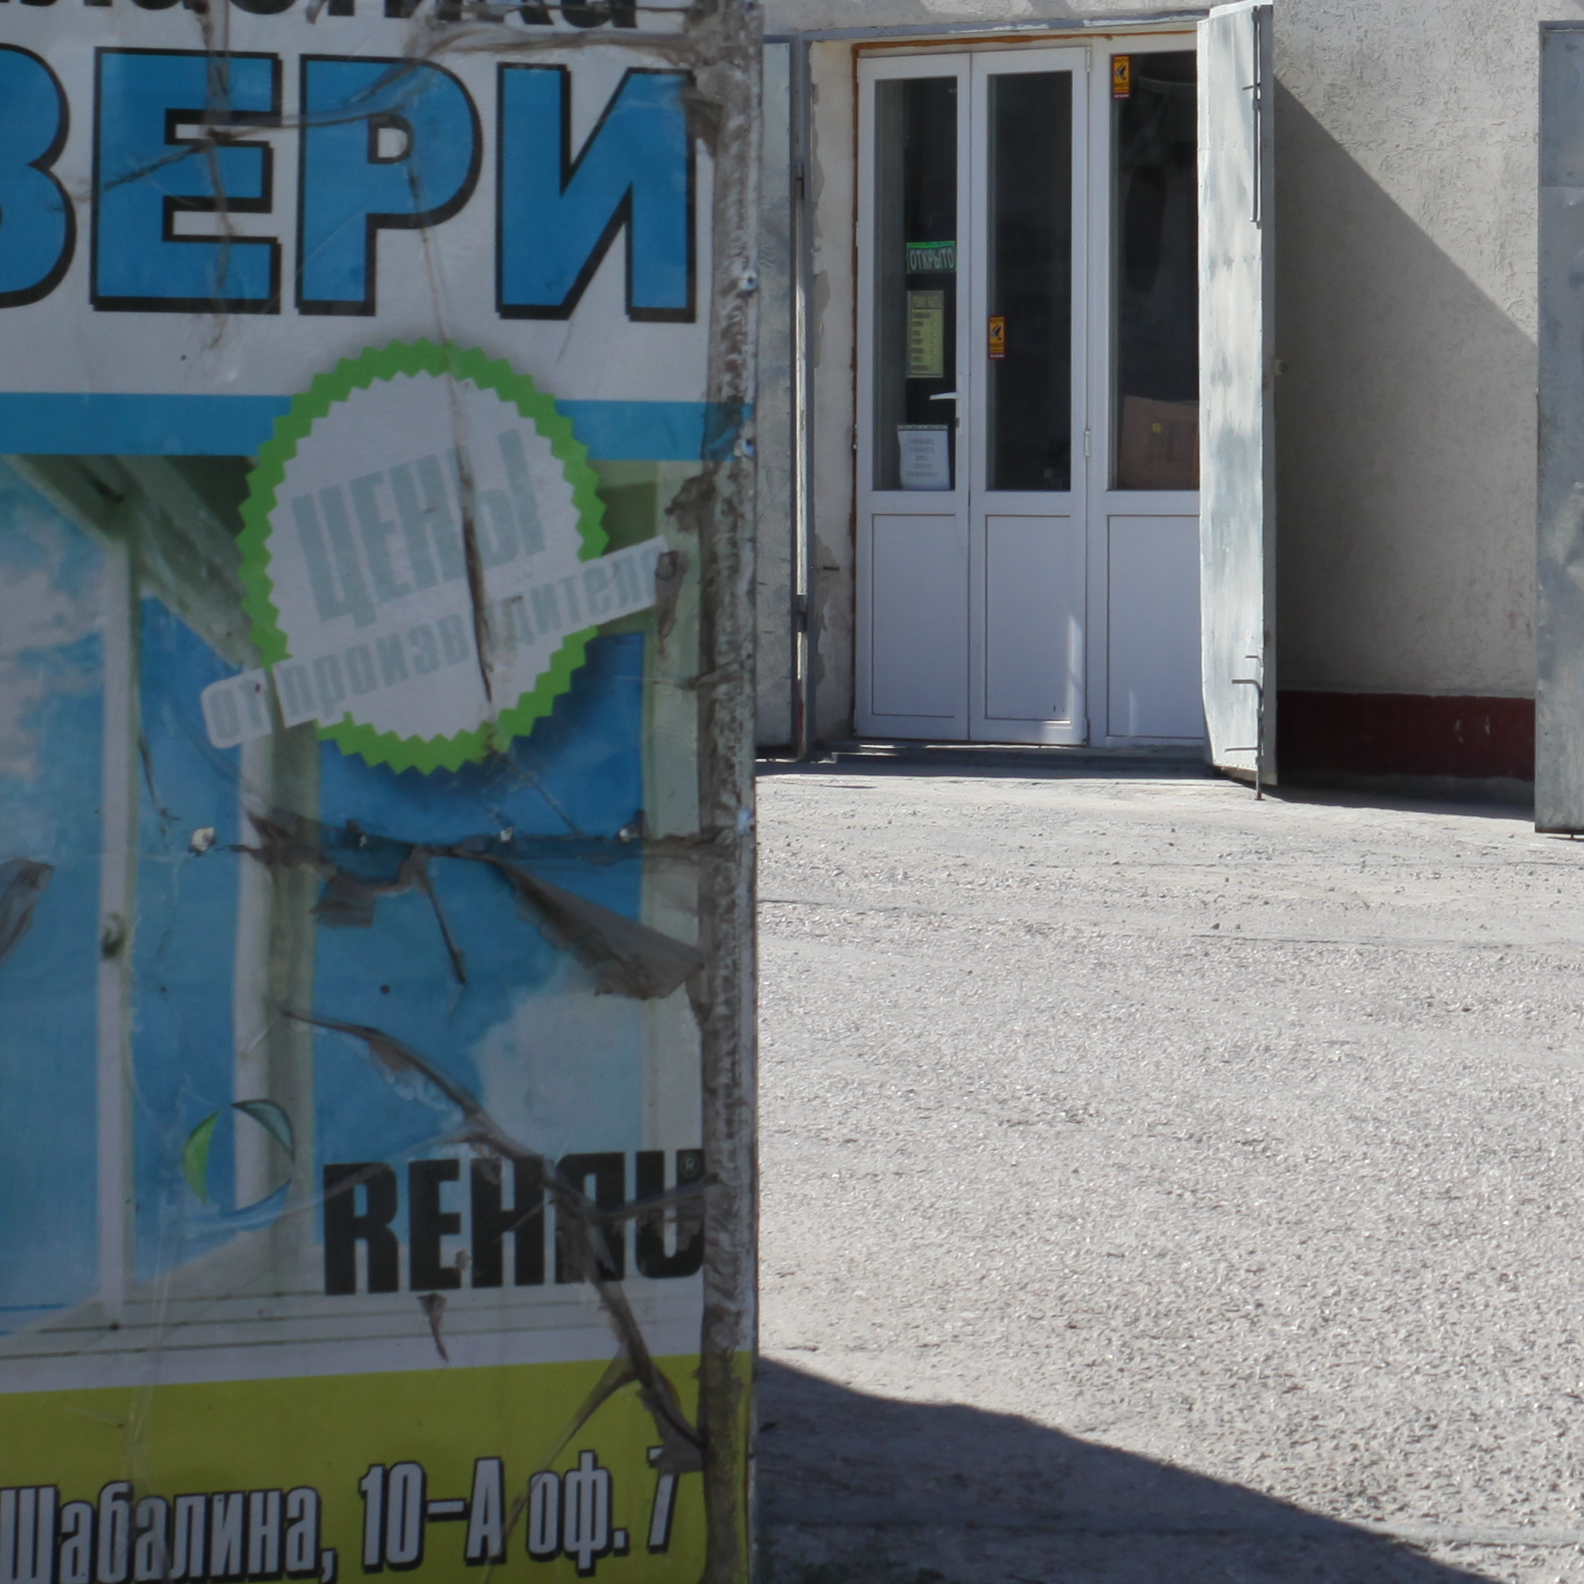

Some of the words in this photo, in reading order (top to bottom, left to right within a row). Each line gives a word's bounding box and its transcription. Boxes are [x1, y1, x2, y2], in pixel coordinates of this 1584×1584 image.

[909, 247, 955, 271] ОТКРЫТО
[291, 428, 545, 629] ЦЕНЫ
[208, 683, 267, 742] от
[0, 1480, 339, 1584] Шабалина,
[526, 1448, 630, 1578] оф.
